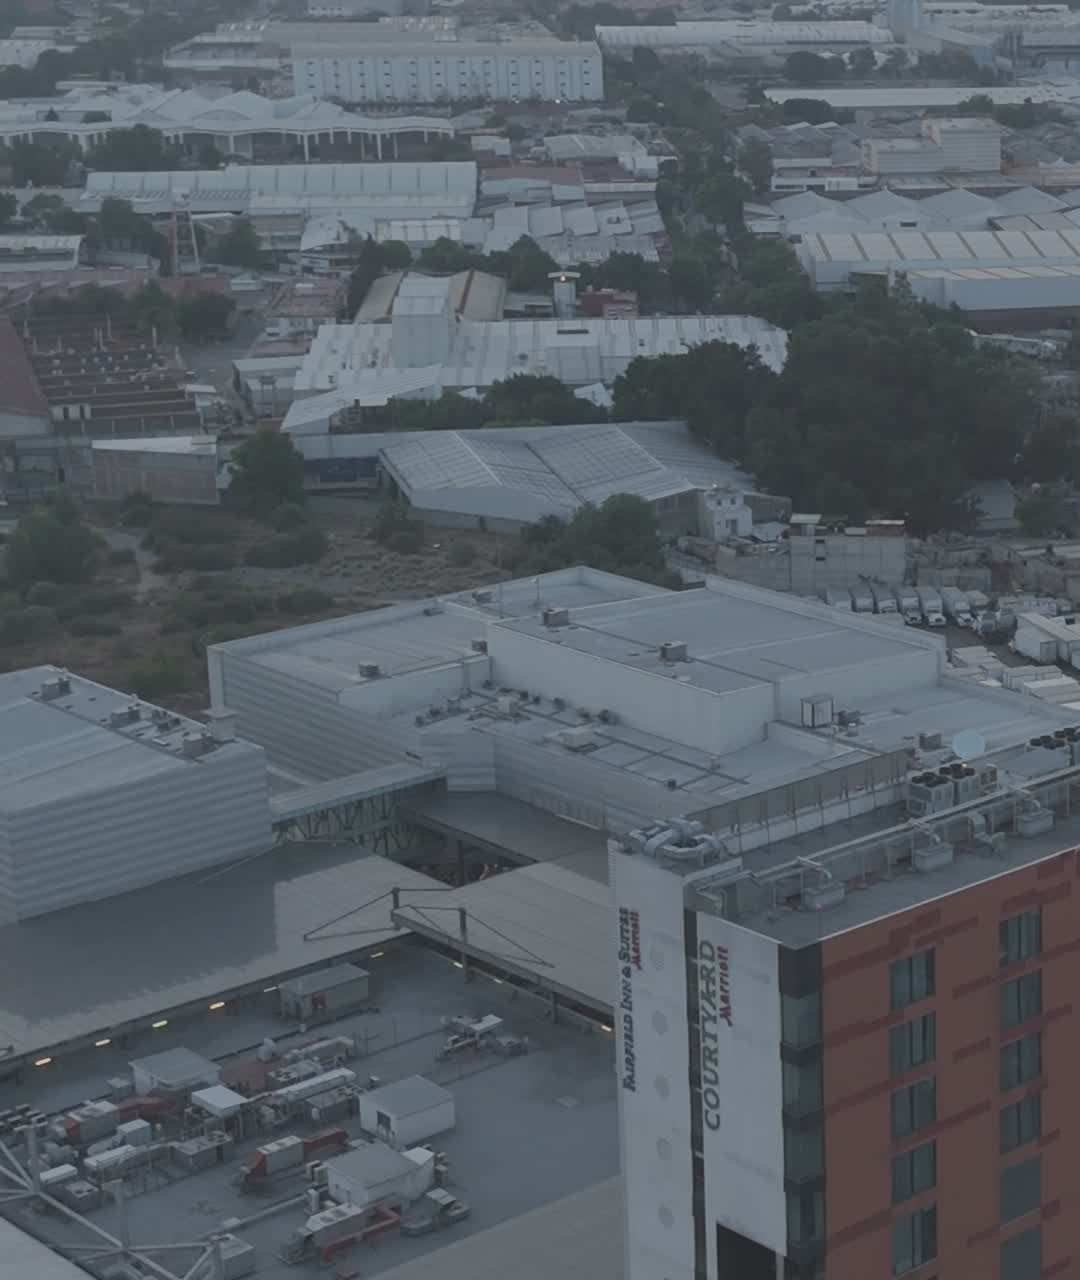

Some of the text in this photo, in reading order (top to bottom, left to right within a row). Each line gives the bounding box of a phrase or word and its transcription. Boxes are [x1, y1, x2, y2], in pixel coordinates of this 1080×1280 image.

[618, 907, 636, 1092] FAIRFIELD INN & SUITES
[630, 911, 642, 970] Marriott
[718, 946, 733, 1026] Marriott
[700, 940, 720, 1131] COURTYARD
